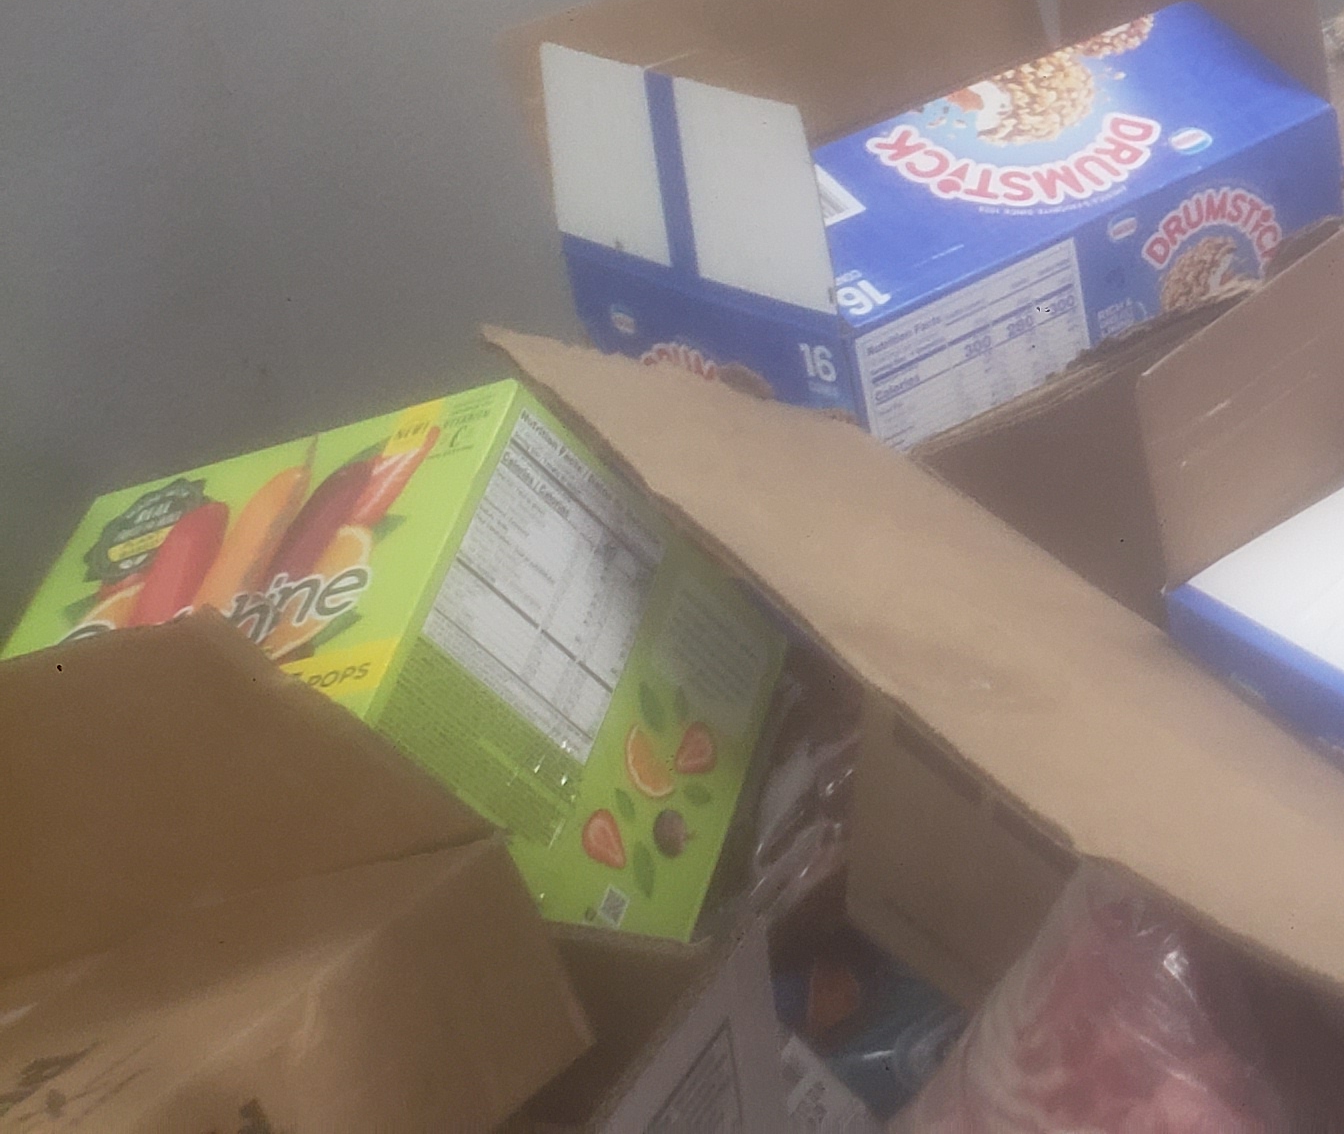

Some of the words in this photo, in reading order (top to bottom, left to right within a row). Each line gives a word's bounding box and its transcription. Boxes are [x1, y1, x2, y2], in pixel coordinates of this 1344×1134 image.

[872, 114, 1160, 204] DRUMSTICK
[838, 275, 891, 317] 16
[798, 342, 837, 382] 16
